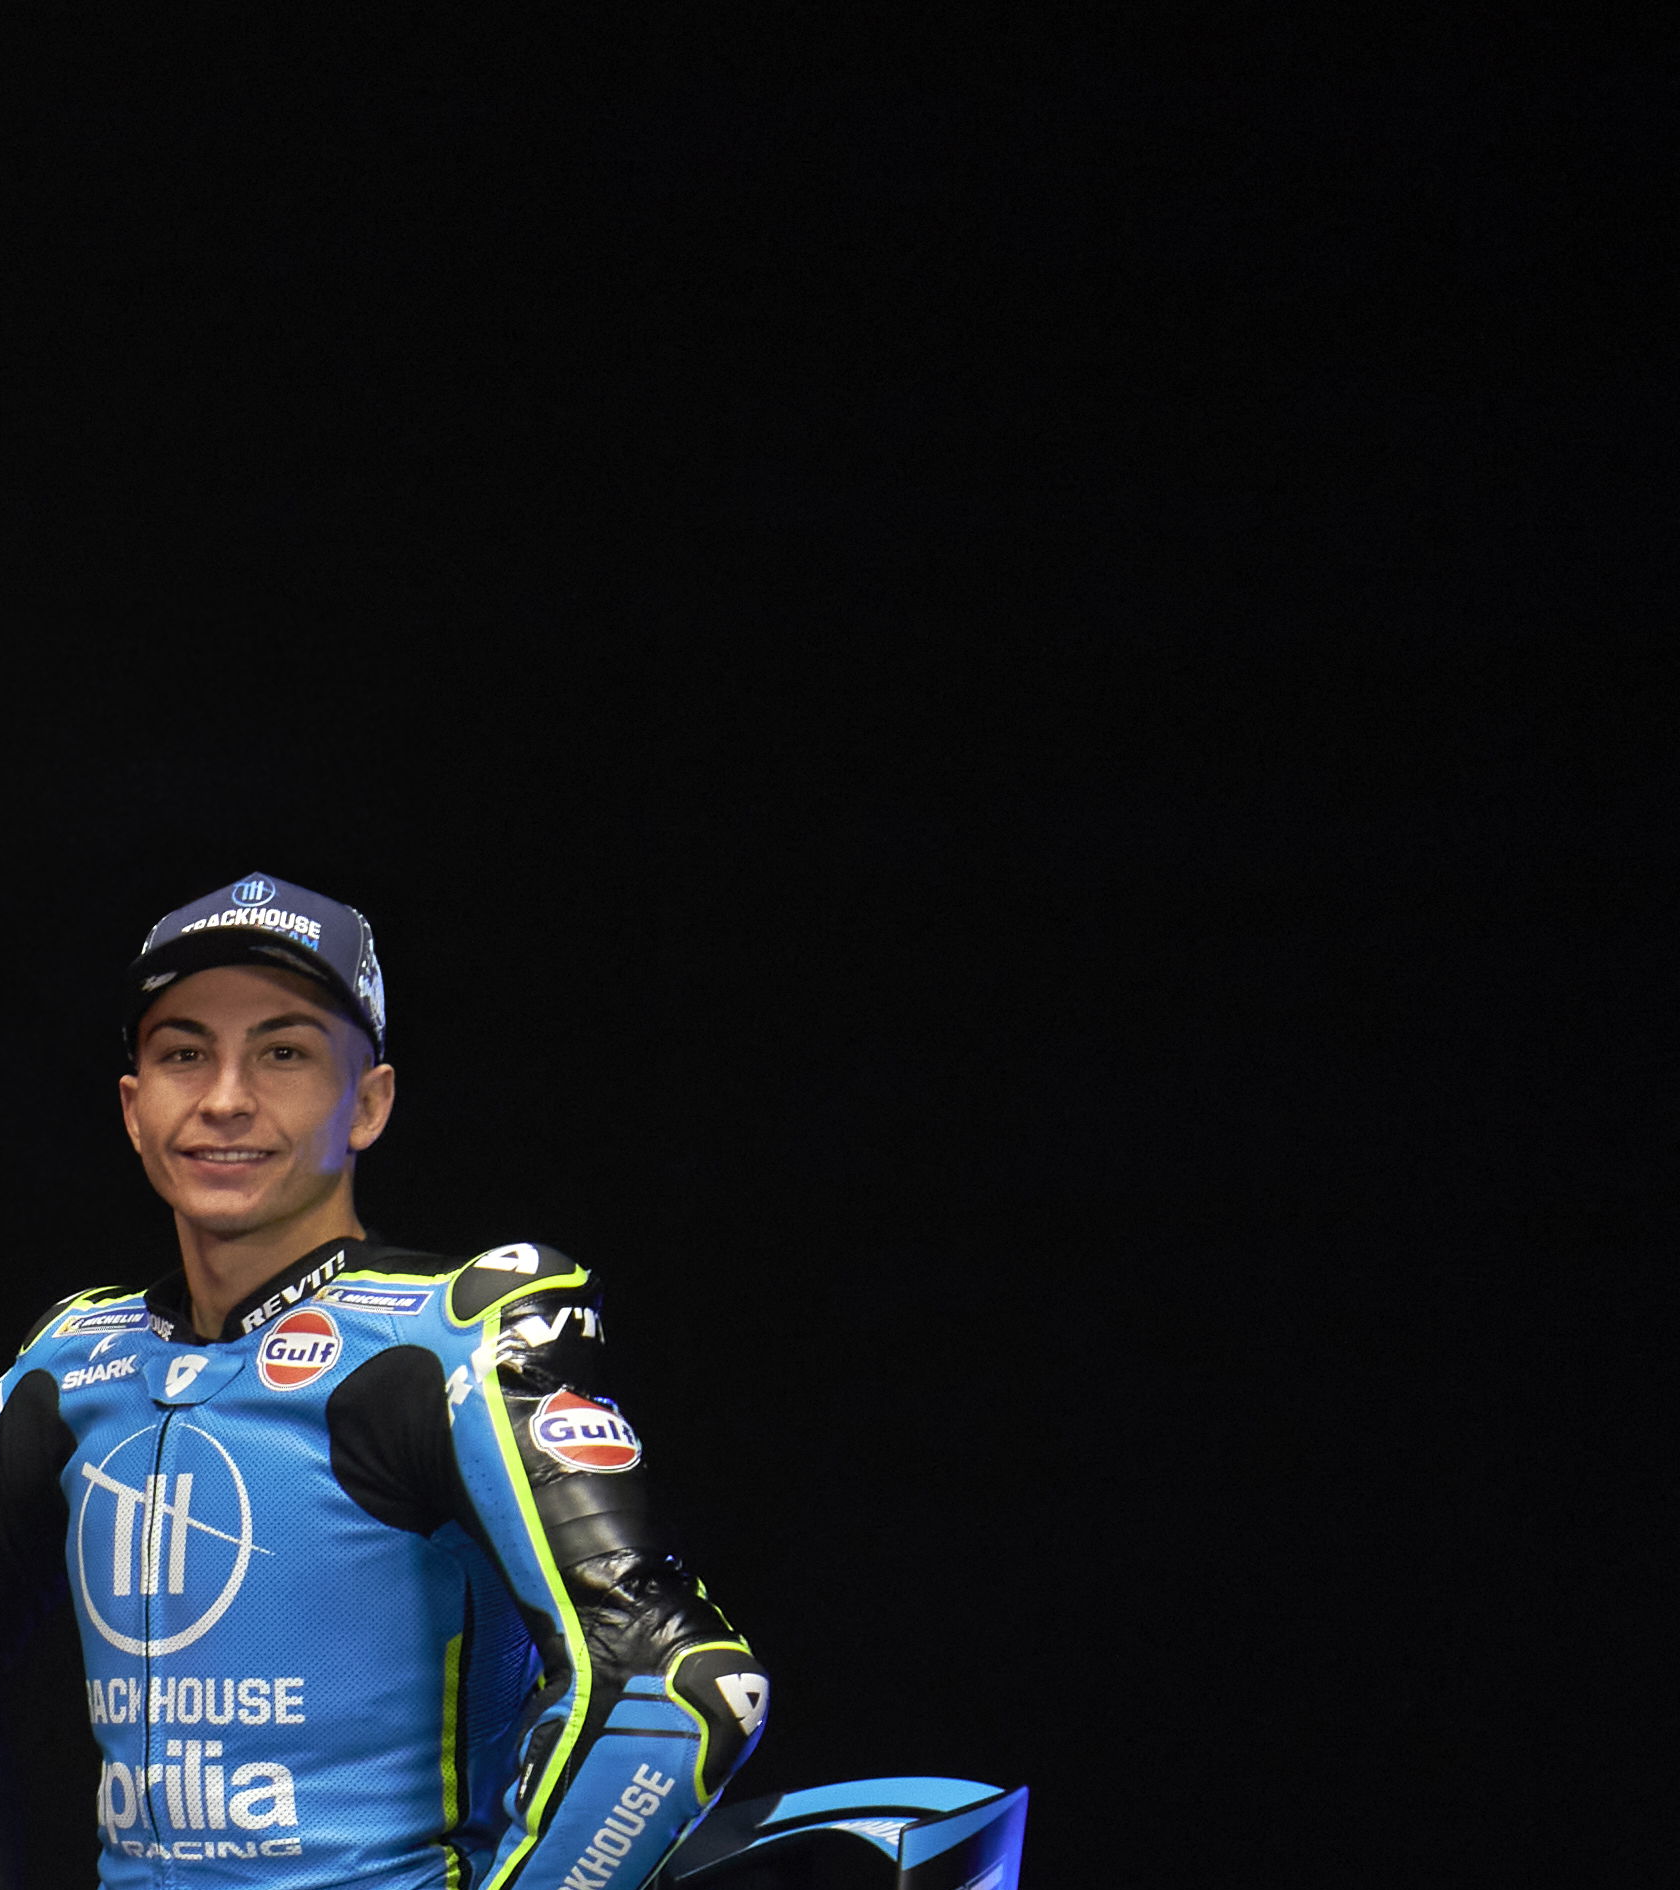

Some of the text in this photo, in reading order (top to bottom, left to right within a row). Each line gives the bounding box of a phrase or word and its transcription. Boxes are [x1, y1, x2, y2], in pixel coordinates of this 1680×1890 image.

[265, 1337, 335, 1364] Gulf
[61, 1354, 138, 1391] SHARK
[96, 1738, 299, 1844] prilia
[121, 1837, 303, 1861] RACING
